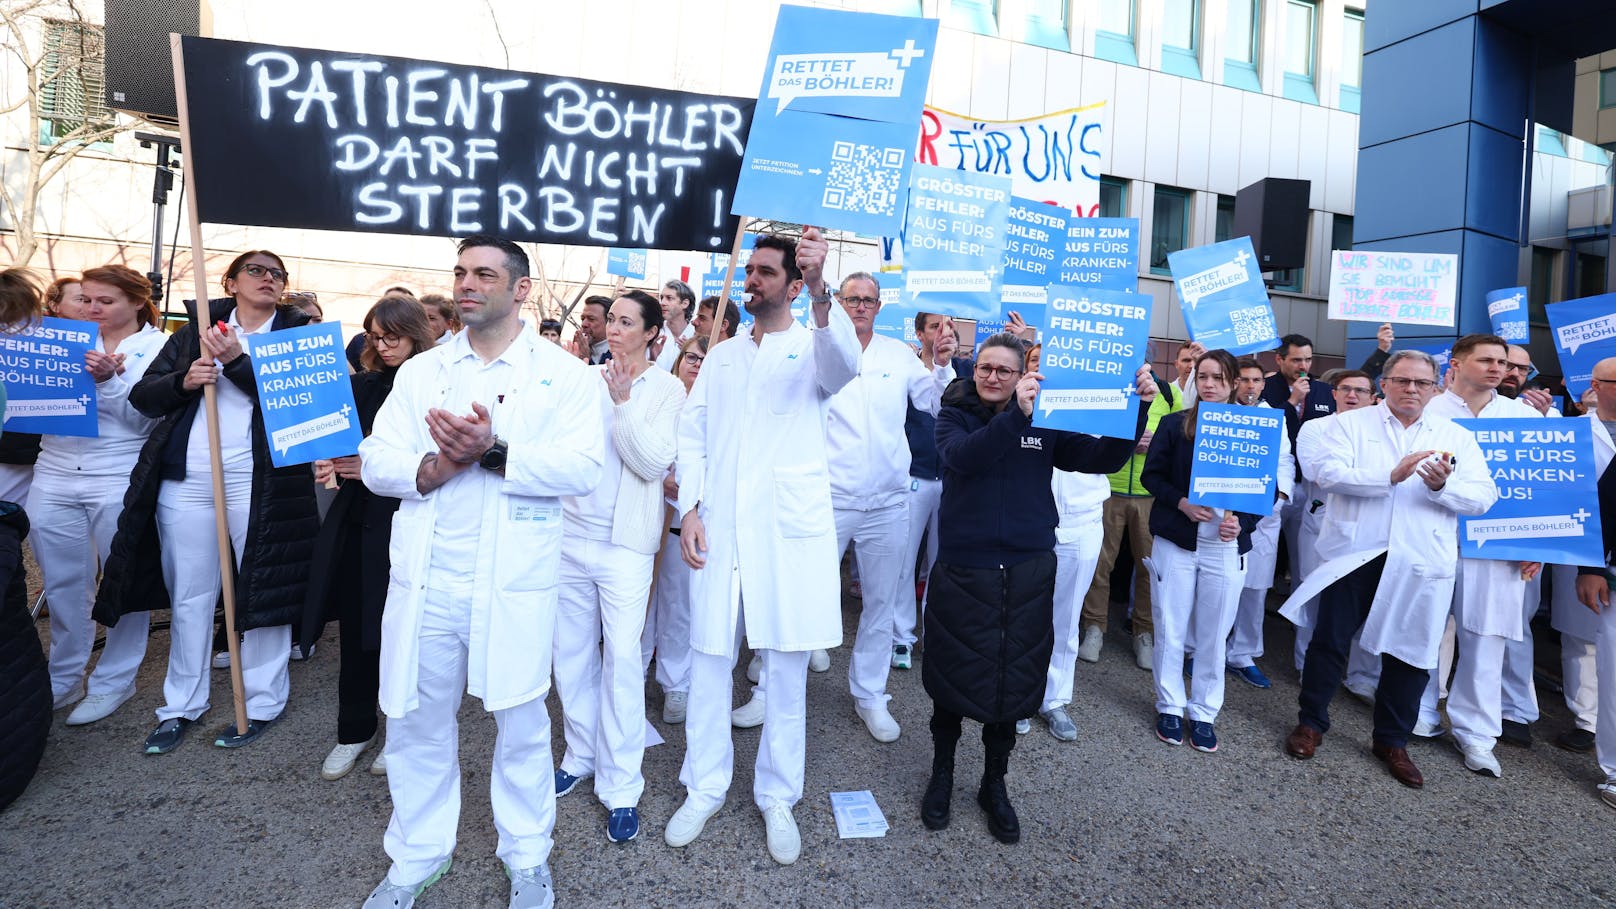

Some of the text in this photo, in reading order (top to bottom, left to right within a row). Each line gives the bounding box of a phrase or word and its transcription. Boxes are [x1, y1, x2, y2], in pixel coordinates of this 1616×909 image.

[781, 59, 856, 74] RETTET
[778, 74, 894, 90] DAS BÖHLER!
[246, 51, 744, 156] PATIENT BÖHLER
[948, 122, 1012, 175] FÜR
[1019, 114, 1102, 183] UNS
[335, 135, 701, 195] DARF NICHT
[917, 176, 1006, 203] GRÖSSTER
[355, 182, 665, 244] STERBEN
[915, 196, 985, 219] FEHLER:
[912, 214, 995, 239] AUS FÜRS
[1008, 206, 1066, 231] RÖSSTER
[1007, 224, 1050, 243] EHLER:
[1098, 227, 1130, 239] ZUM
[911, 232, 985, 257] BÖHLER!
[1006, 240, 1055, 260] US FÜRS
[1093, 240, 1129, 253] FÜRS
[1004, 254, 1047, 275] ÖHLER!
[1339, 254, 1452, 274] WIR SIND UM
[911, 278, 938, 286] RETTET
[939, 278, 954, 286] DAS
[1060, 271, 1102, 283] HAUS!
[1183, 270, 1220, 289] RETTET
[1199, 272, 1245, 294] BÖHLER!
[1375, 273, 1442, 289] BEMÜHT
[1052, 297, 1146, 321] GRÖSSTER
[1050, 316, 1125, 337] FEHLER:
[1562, 319, 1610, 337] RETTET
[255, 334, 334, 358] NEIN ZUM
[1047, 335, 1134, 357] AUS FÜRS
[1565, 335, 1580, 343] DAS
[35, 358, 82, 374] FÜRS
[259, 351, 337, 376] AUS FÜRS
[1046, 353, 1123, 376] BÖHLER!
[263, 369, 344, 393] KRANKEN-
[266, 391, 313, 411] HAUS!
[1202, 411, 1279, 428] GRÖSSTER
[277, 431, 301, 443] RETTET
[302, 426, 316, 437] DAS
[1020, 436, 1042, 446] LBK
[1200, 424, 1261, 441] FEHLER:
[1476, 430, 1575, 443] EIN ZUM
[1199, 438, 1269, 456] AUS FÜRS
[1483, 446, 1576, 463] US FÜRS
[1198, 451, 1260, 469] BÖHLER!
[1488, 468, 1585, 482] ANKEN-
[1498, 486, 1533, 500] US!
[1473, 521, 1575, 534] RETTET DAS BÖHLER!
